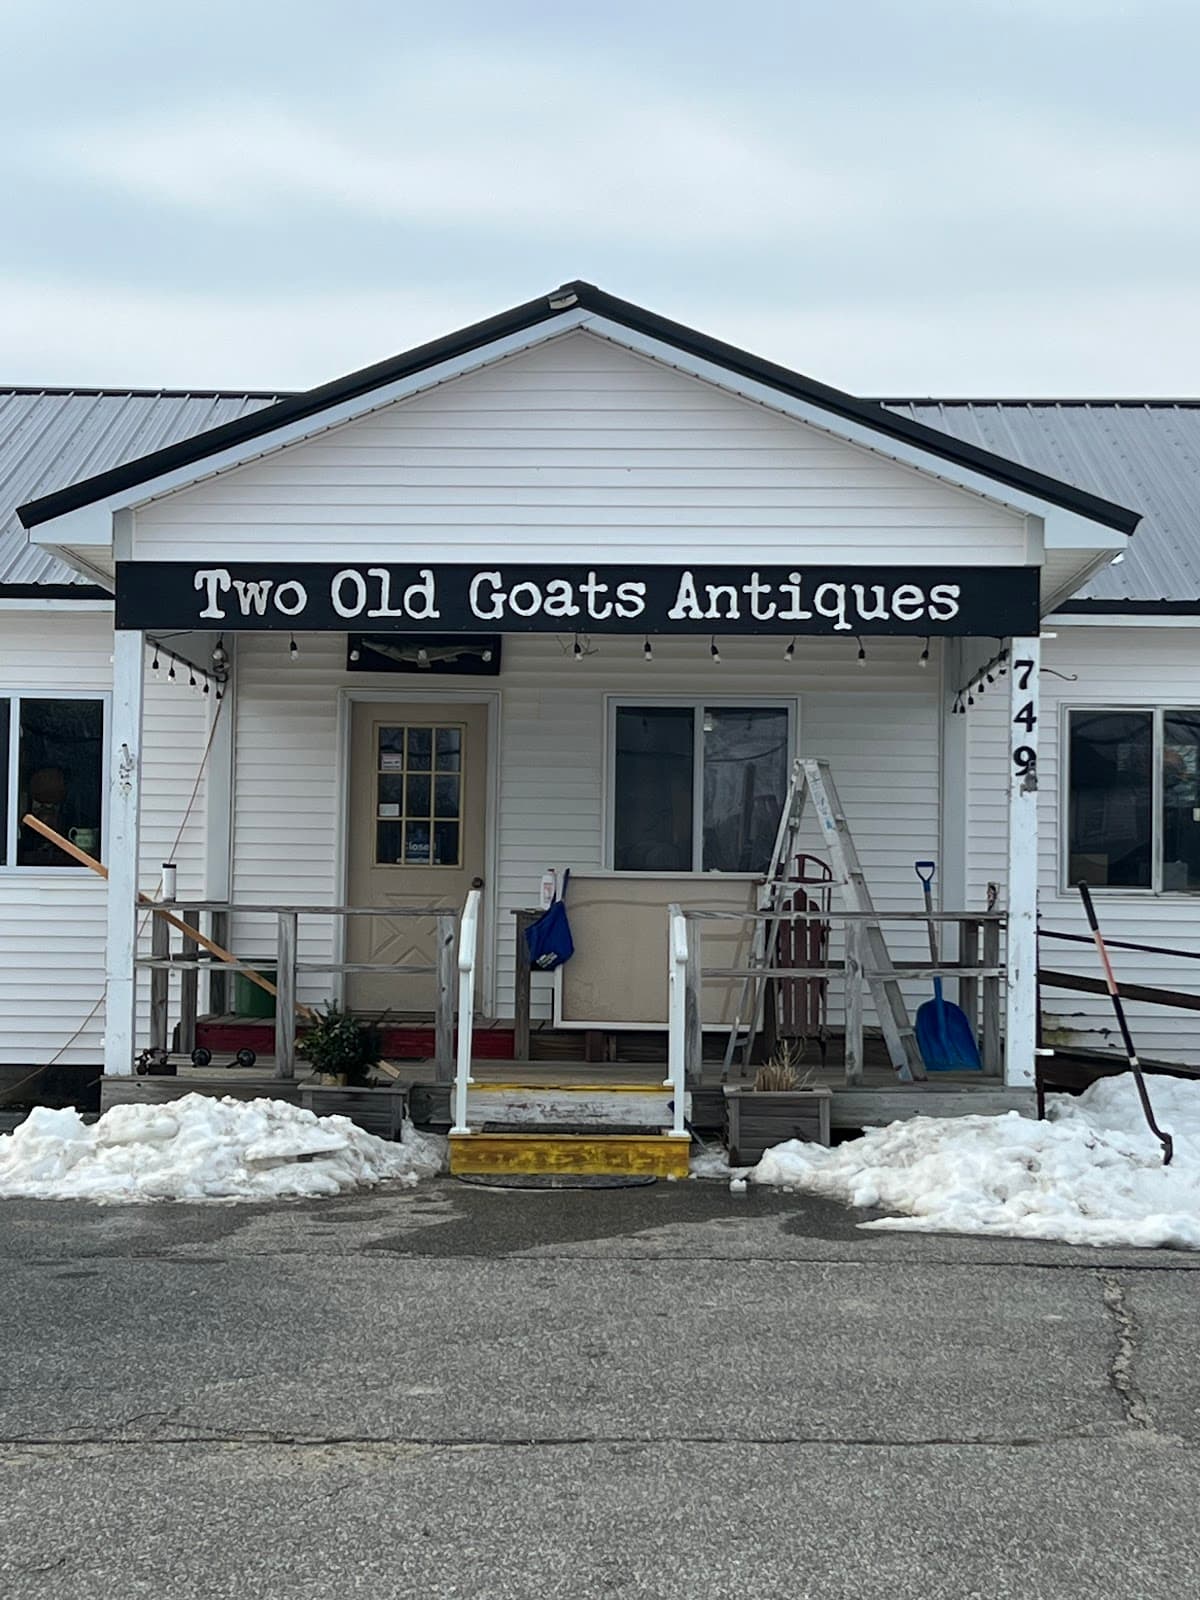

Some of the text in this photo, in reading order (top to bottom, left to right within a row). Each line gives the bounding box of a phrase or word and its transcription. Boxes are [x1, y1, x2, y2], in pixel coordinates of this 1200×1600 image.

[194, 568, 962, 631] Two Old Goats Antiques
